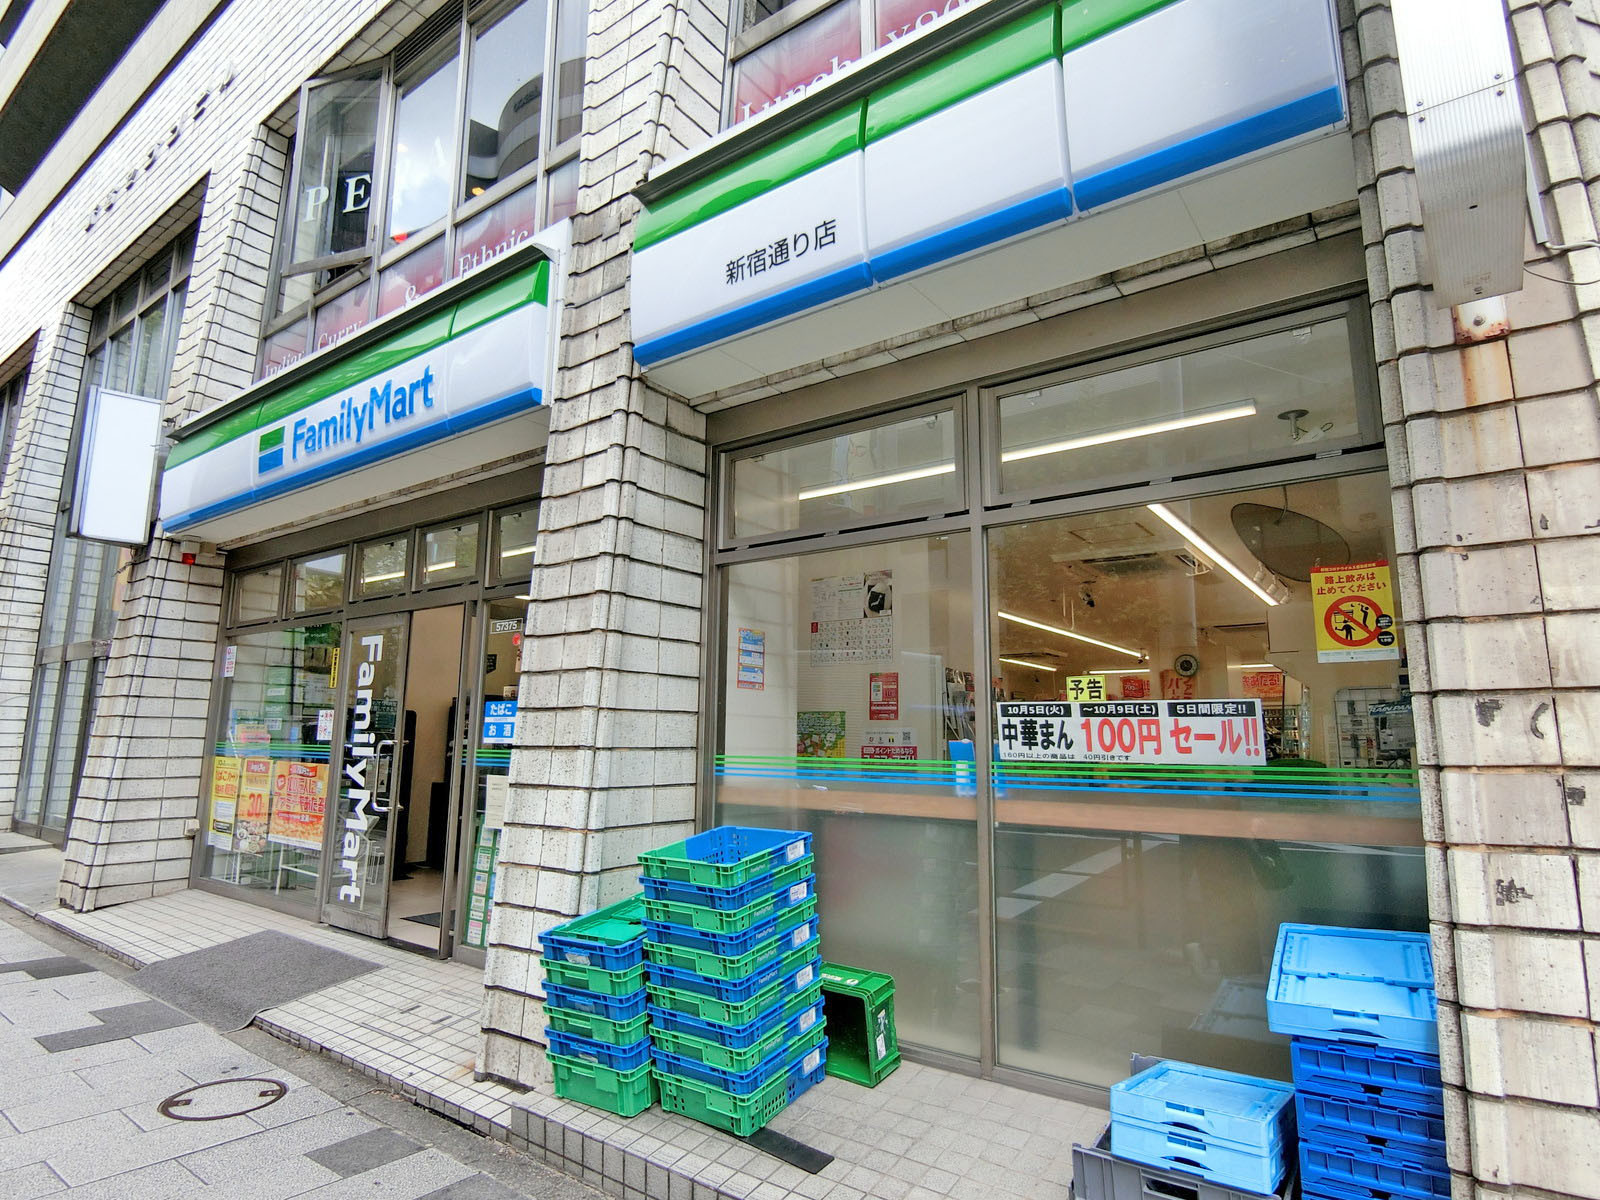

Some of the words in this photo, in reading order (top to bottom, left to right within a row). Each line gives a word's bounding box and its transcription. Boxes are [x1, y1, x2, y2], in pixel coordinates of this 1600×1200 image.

[458, 229, 528, 279] Ethnic
[726, 219, 837, 285] 新宿通り店
[292, 365, 434, 460] FamilyMart
[1324, 572, 1376, 585] 路上飲みは
[1316, 582, 1387, 595] 止めてください
[496, 620, 518, 632] 57375
[1070, 678, 1103, 700] 予告
[490, 703, 512, 716] たばこ
[1007, 704, 1064, 715] 10月5日(火)
[1176, 702, 1247, 714] 5日間限定!!
[1001, 718, 1074, 751] 中華まん
[1080, 718, 1162, 755] 100円
[1169, 717, 1260, 757] セール!!
[1003, 752, 1075, 760] 160円以上の商品は
[339, 634, 384, 903] FamilyMart
